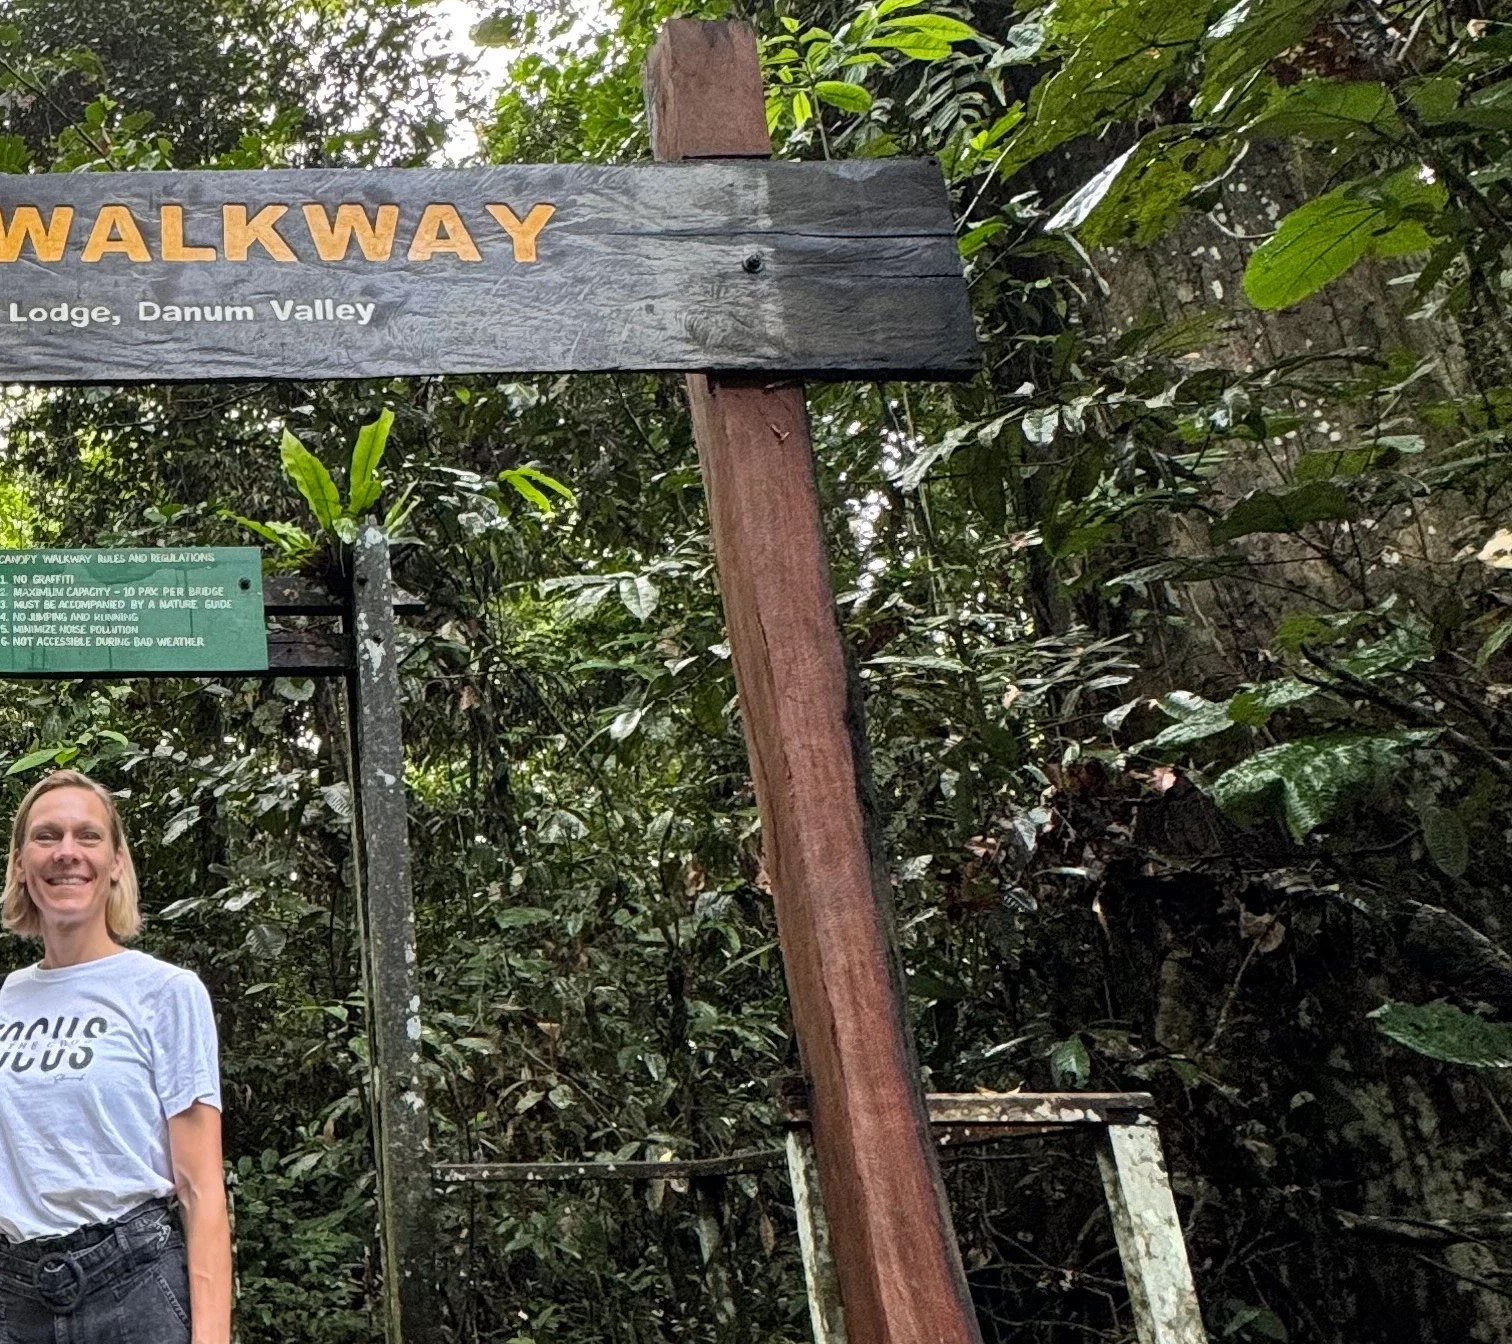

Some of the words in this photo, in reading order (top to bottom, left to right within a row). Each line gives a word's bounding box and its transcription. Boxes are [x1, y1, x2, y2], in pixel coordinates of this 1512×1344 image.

[9, 301, 121, 327] Lodge,
[139, 300, 254, 323] Danum
[269, 299, 375, 326] Valley
[42, 554, 92, 564] WALKWAY
[97, 554, 126, 564] RULES
[128, 553, 148, 563] AND
[150, 552, 215, 563] REGULATIONS
[0, 575, 8, 585] 1.
[13, 575, 27, 585] NO
[32, 574, 74, 585] GRAFFITI
[0, 587, 8, 597] 2.
[13, 587, 64, 597] MAXIMUM
[66, 587, 111, 597] CAPACITY
[123, 587, 135, 597] 10
[163, 587, 184, 597] PER
[189, 586, 224, 596] BRIDGE
[0, 600, 8, 609] 3.
[13, 600, 40, 610] MUST
[43, 600, 56, 609] BE
[58, 600, 125, 609] ACCOMPANIED
[130, 599, 145, 609] BY
[148, 599, 155, 609] A
[159, 599, 198, 609] NATURE
[205, 599, 232, 609] GUIDE
[0, 612, 9, 622] 4.
[13, 612, 26, 621] NO
[28, 612, 67, 622] JUMPING
[70, 613, 90, 621] AND
[94, 613, 139, 622] RUNNING
[0, 625, 9, 634] 5.
[13, 625, 57, 634] MINIMIZE
[59, 625, 87, 634] NOISE
[90, 625, 138, 634] POLLUTION
[0, 637, 10, 646] 6.
[13, 637, 34, 646] NOT
[36, 637, 91, 646] ACCESSIBLE
[96, 637, 131, 647] DURING
[134, 637, 153, 647] BAD
[156, 637, 205, 647] WEATHER
